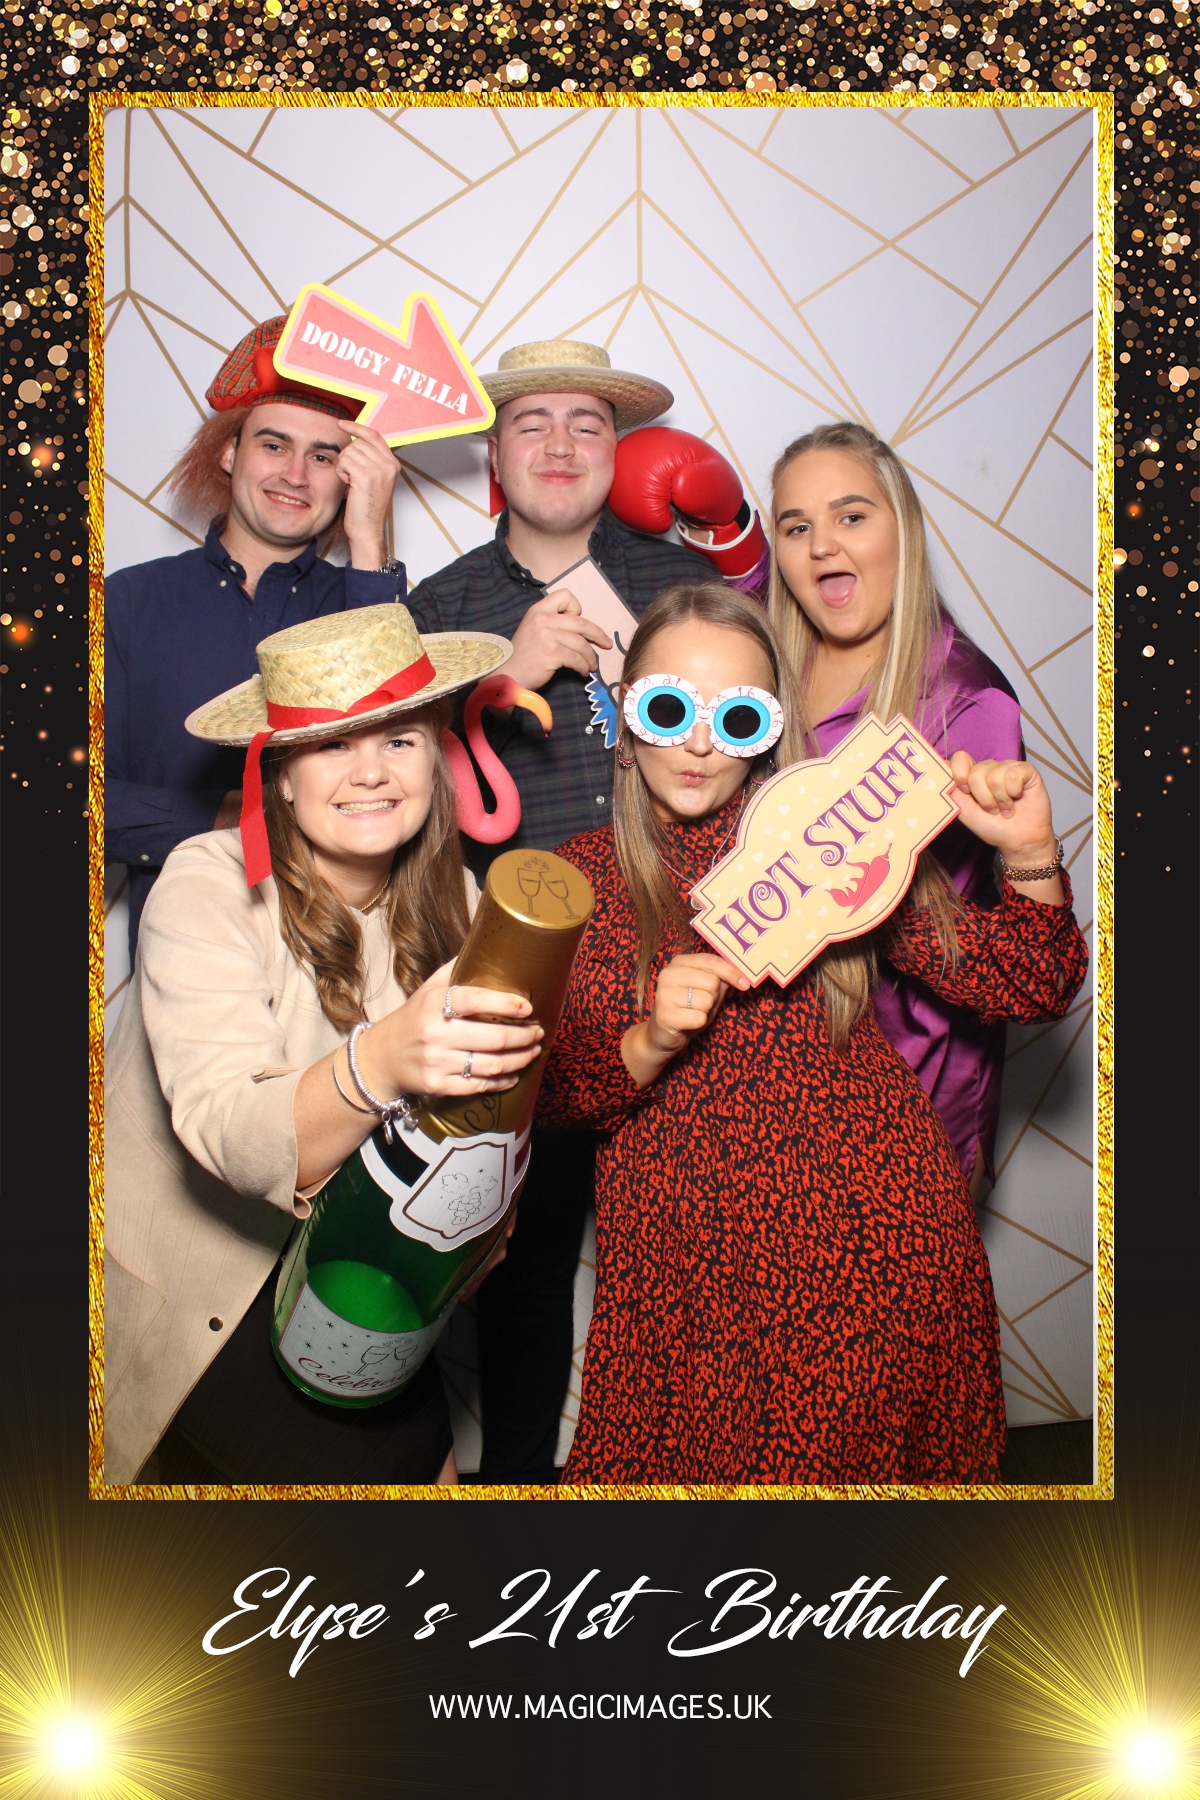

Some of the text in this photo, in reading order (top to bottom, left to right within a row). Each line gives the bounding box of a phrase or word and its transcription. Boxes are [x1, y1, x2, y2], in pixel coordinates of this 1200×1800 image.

[300, 321, 468, 415] DODGY FELLA
[715, 731, 926, 955] HOT STUFF
